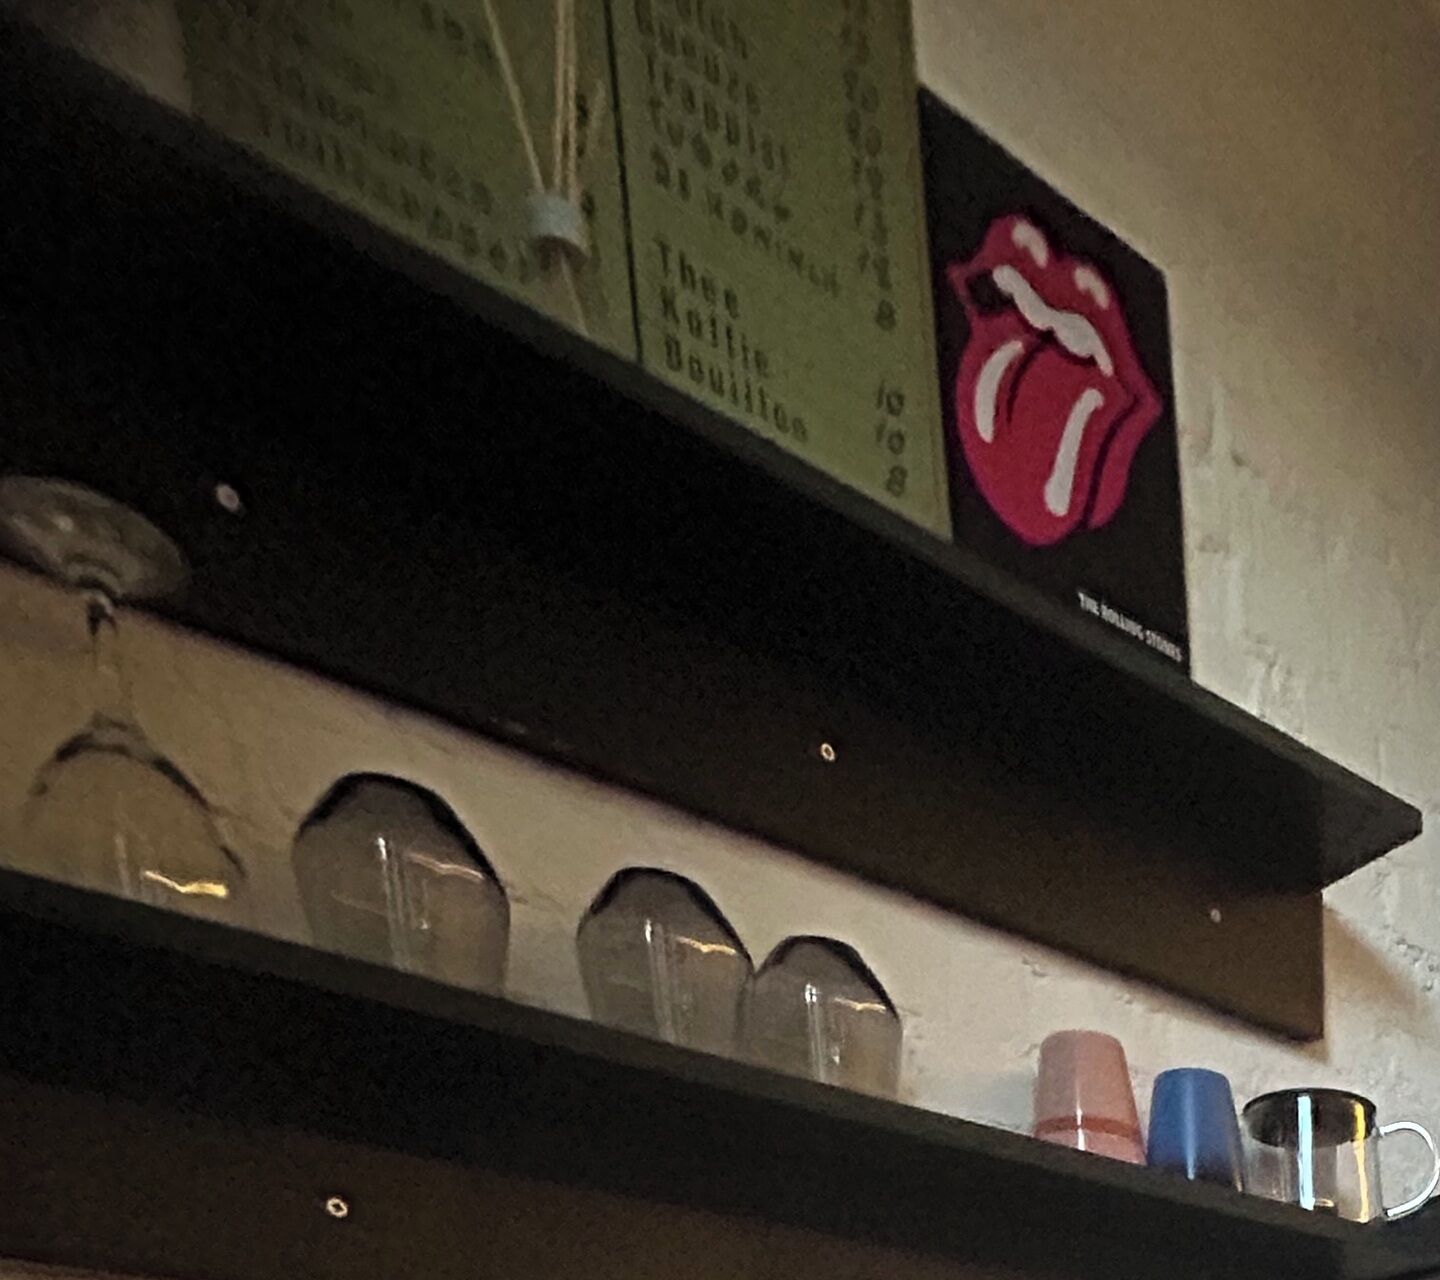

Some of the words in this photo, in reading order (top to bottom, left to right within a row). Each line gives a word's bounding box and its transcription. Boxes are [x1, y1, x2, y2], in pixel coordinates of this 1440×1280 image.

[653, 232, 739, 320] Thee
[659, 284, 770, 379] Koffie
[1077, 591, 1100, 616] THE
[1101, 600, 1144, 641] ROLLING
[1146, 629, 1185, 663] STONES
